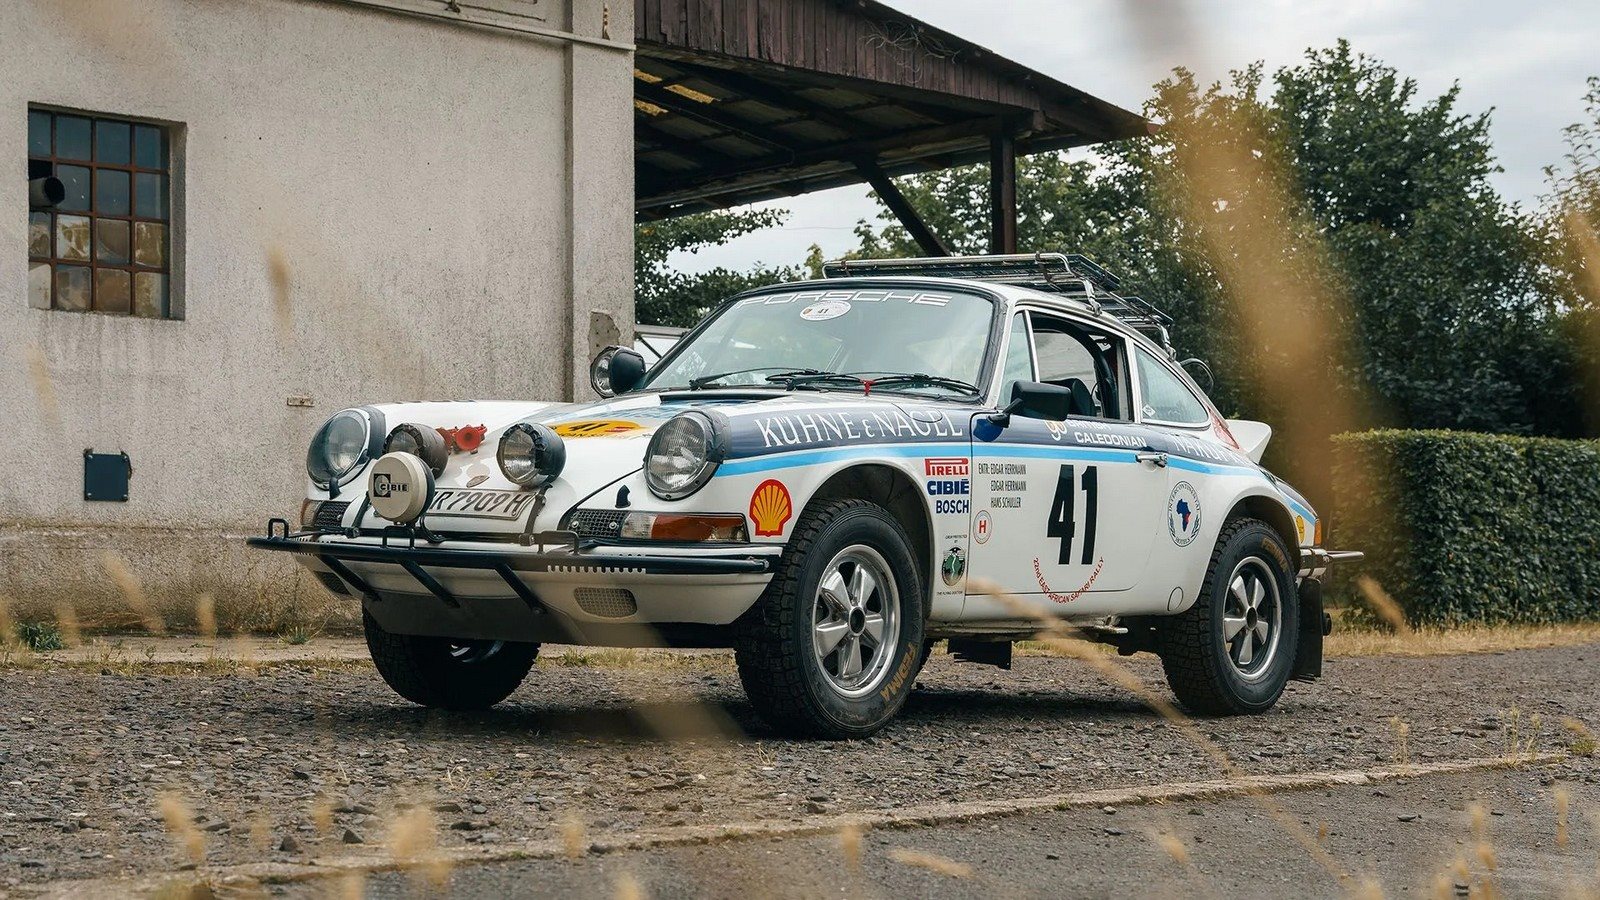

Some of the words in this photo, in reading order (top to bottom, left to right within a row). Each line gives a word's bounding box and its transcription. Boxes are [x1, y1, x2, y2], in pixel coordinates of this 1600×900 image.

[736, 291, 953, 309] PORSCHE
[754, 413, 860, 448] KÜHNE
[873, 411, 963, 437] NAGEL
[1074, 432, 1148, 447] CALEDONIAN
[924, 458, 969, 476] PIRELLI
[990, 463, 1004, 475] EDGAR
[990, 480, 1004, 491] EDGAR
[430, 491, 454, 511] R
[447, 491, 511, 513] 7909
[936, 500, 969, 514] BOSCH
[1046, 464, 1098, 565] 41
[979, 520, 987, 534] H
[1033, 557, 1043, 579] 22nd
[1047, 592, 1071, 604] AFRICAN
[1089, 556, 1104, 585] RALLY
